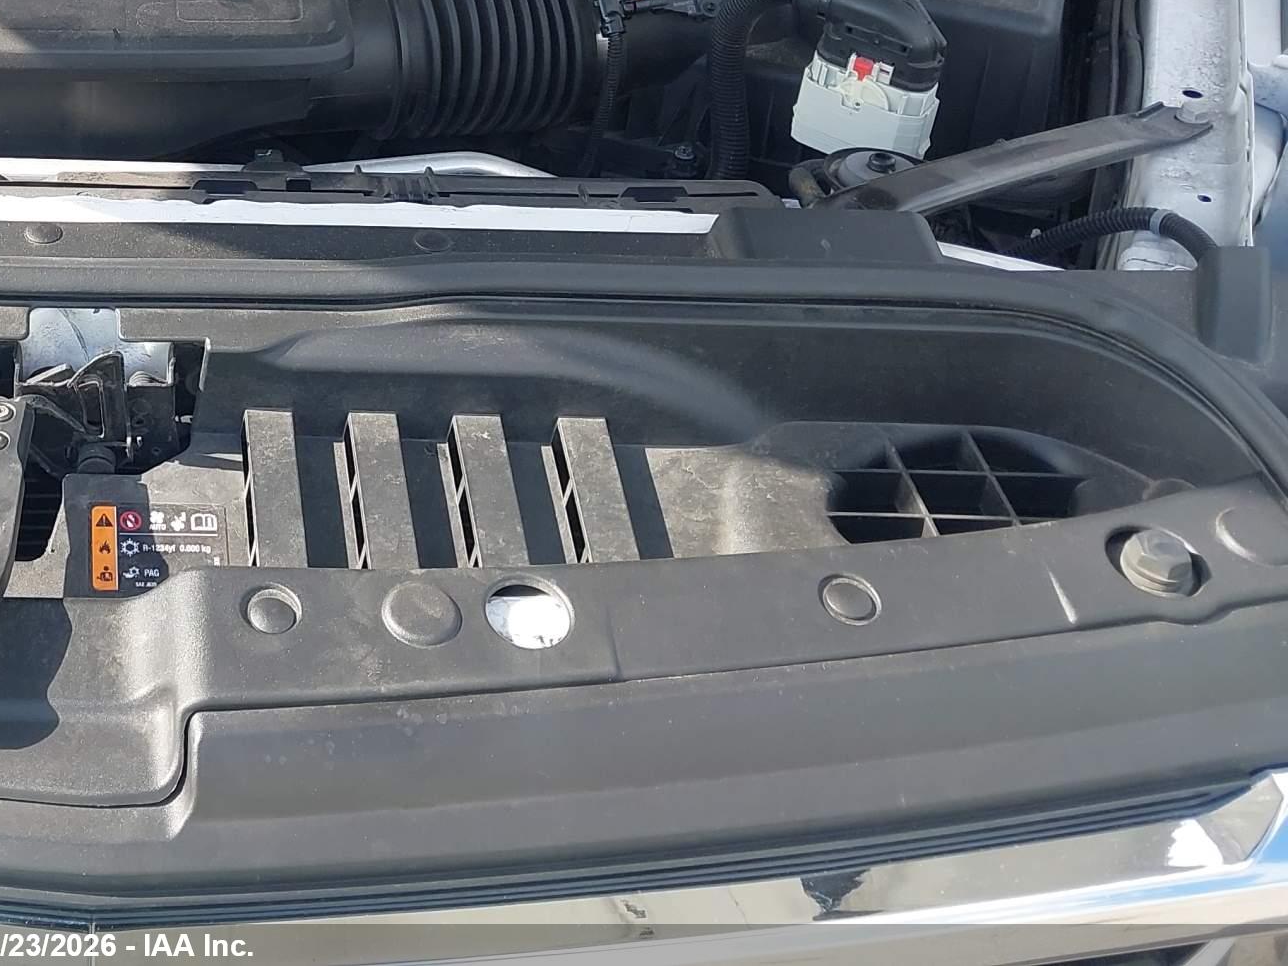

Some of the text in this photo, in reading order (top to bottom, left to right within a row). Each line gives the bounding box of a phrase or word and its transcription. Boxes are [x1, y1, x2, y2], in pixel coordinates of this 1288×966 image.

[149, 523, 167, 531] AUTO
[200, 544, 212, 554] kg
[144, 568, 160, 578] PAG
